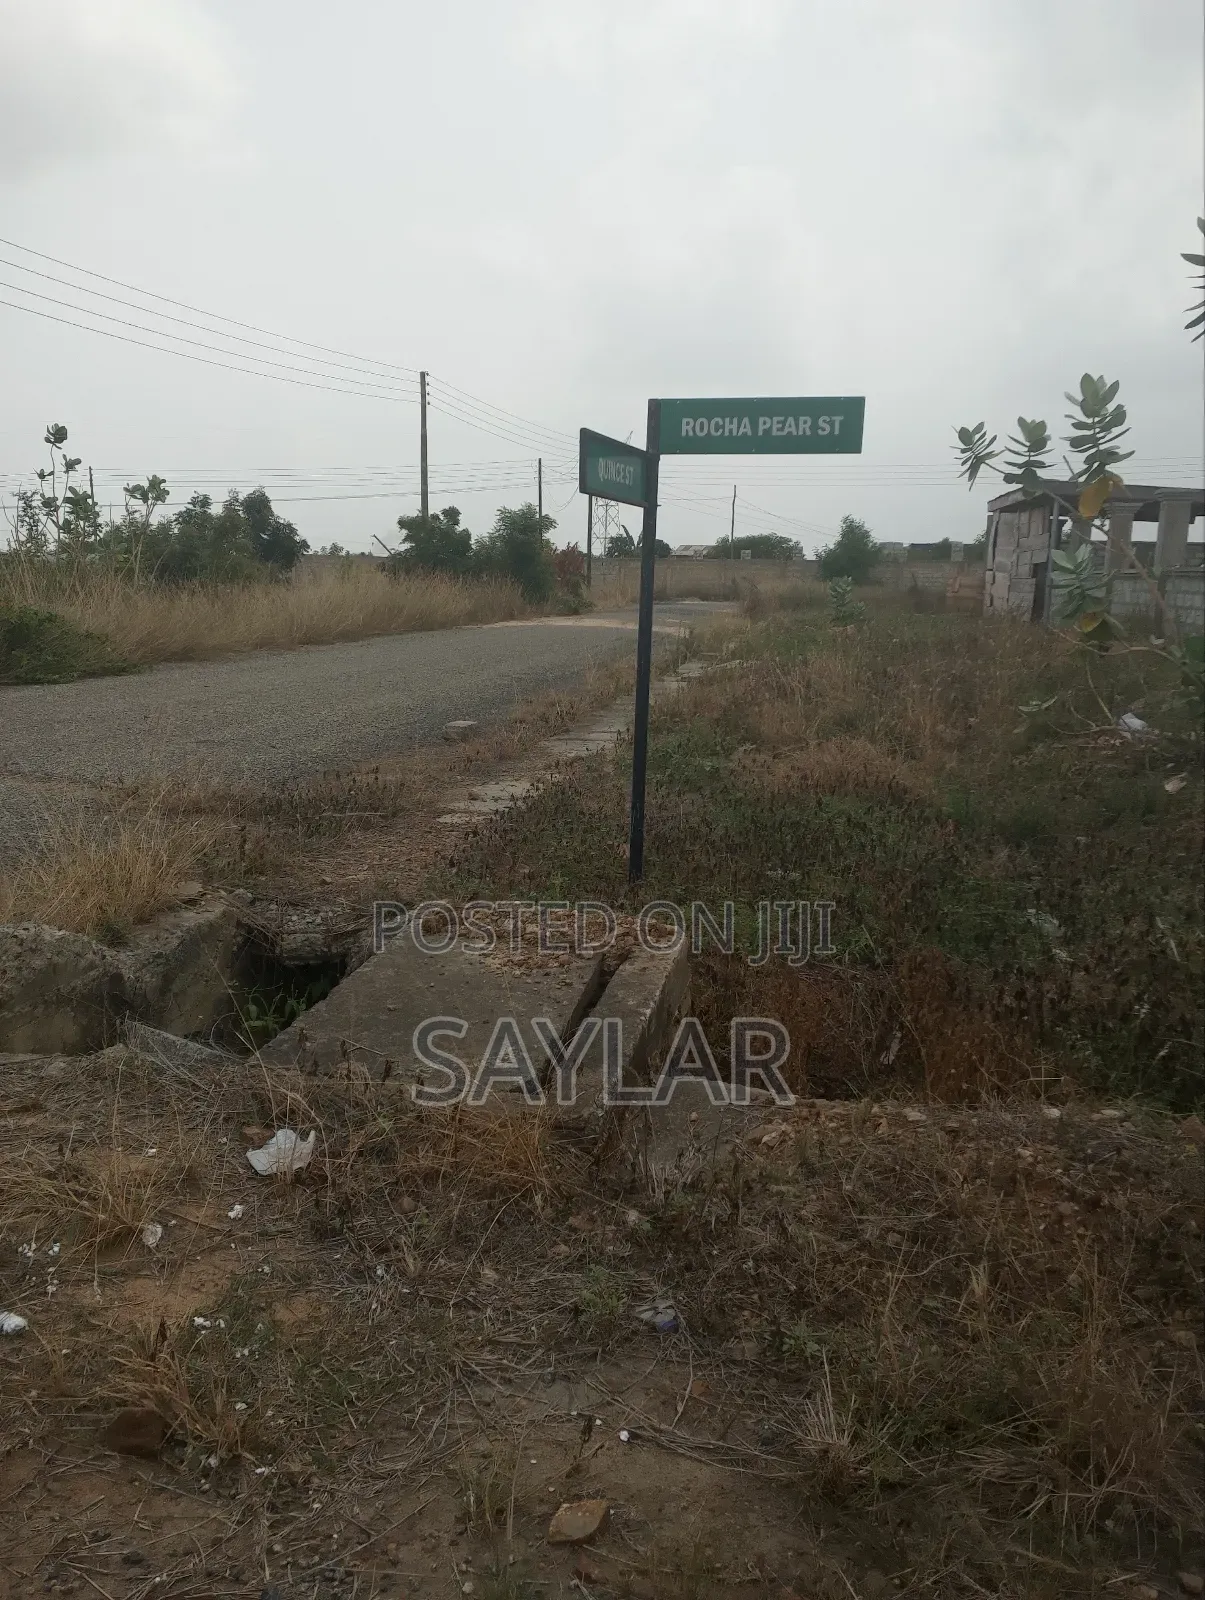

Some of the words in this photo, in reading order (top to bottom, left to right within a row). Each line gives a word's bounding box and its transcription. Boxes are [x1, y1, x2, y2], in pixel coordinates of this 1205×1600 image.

[681, 416, 752, 437] ROCHA
[757, 416, 812, 436] PEAR
[817, 415, 844, 436] ST
[598, 457, 625, 484] QUINCE
[625, 465, 634, 487] ST
